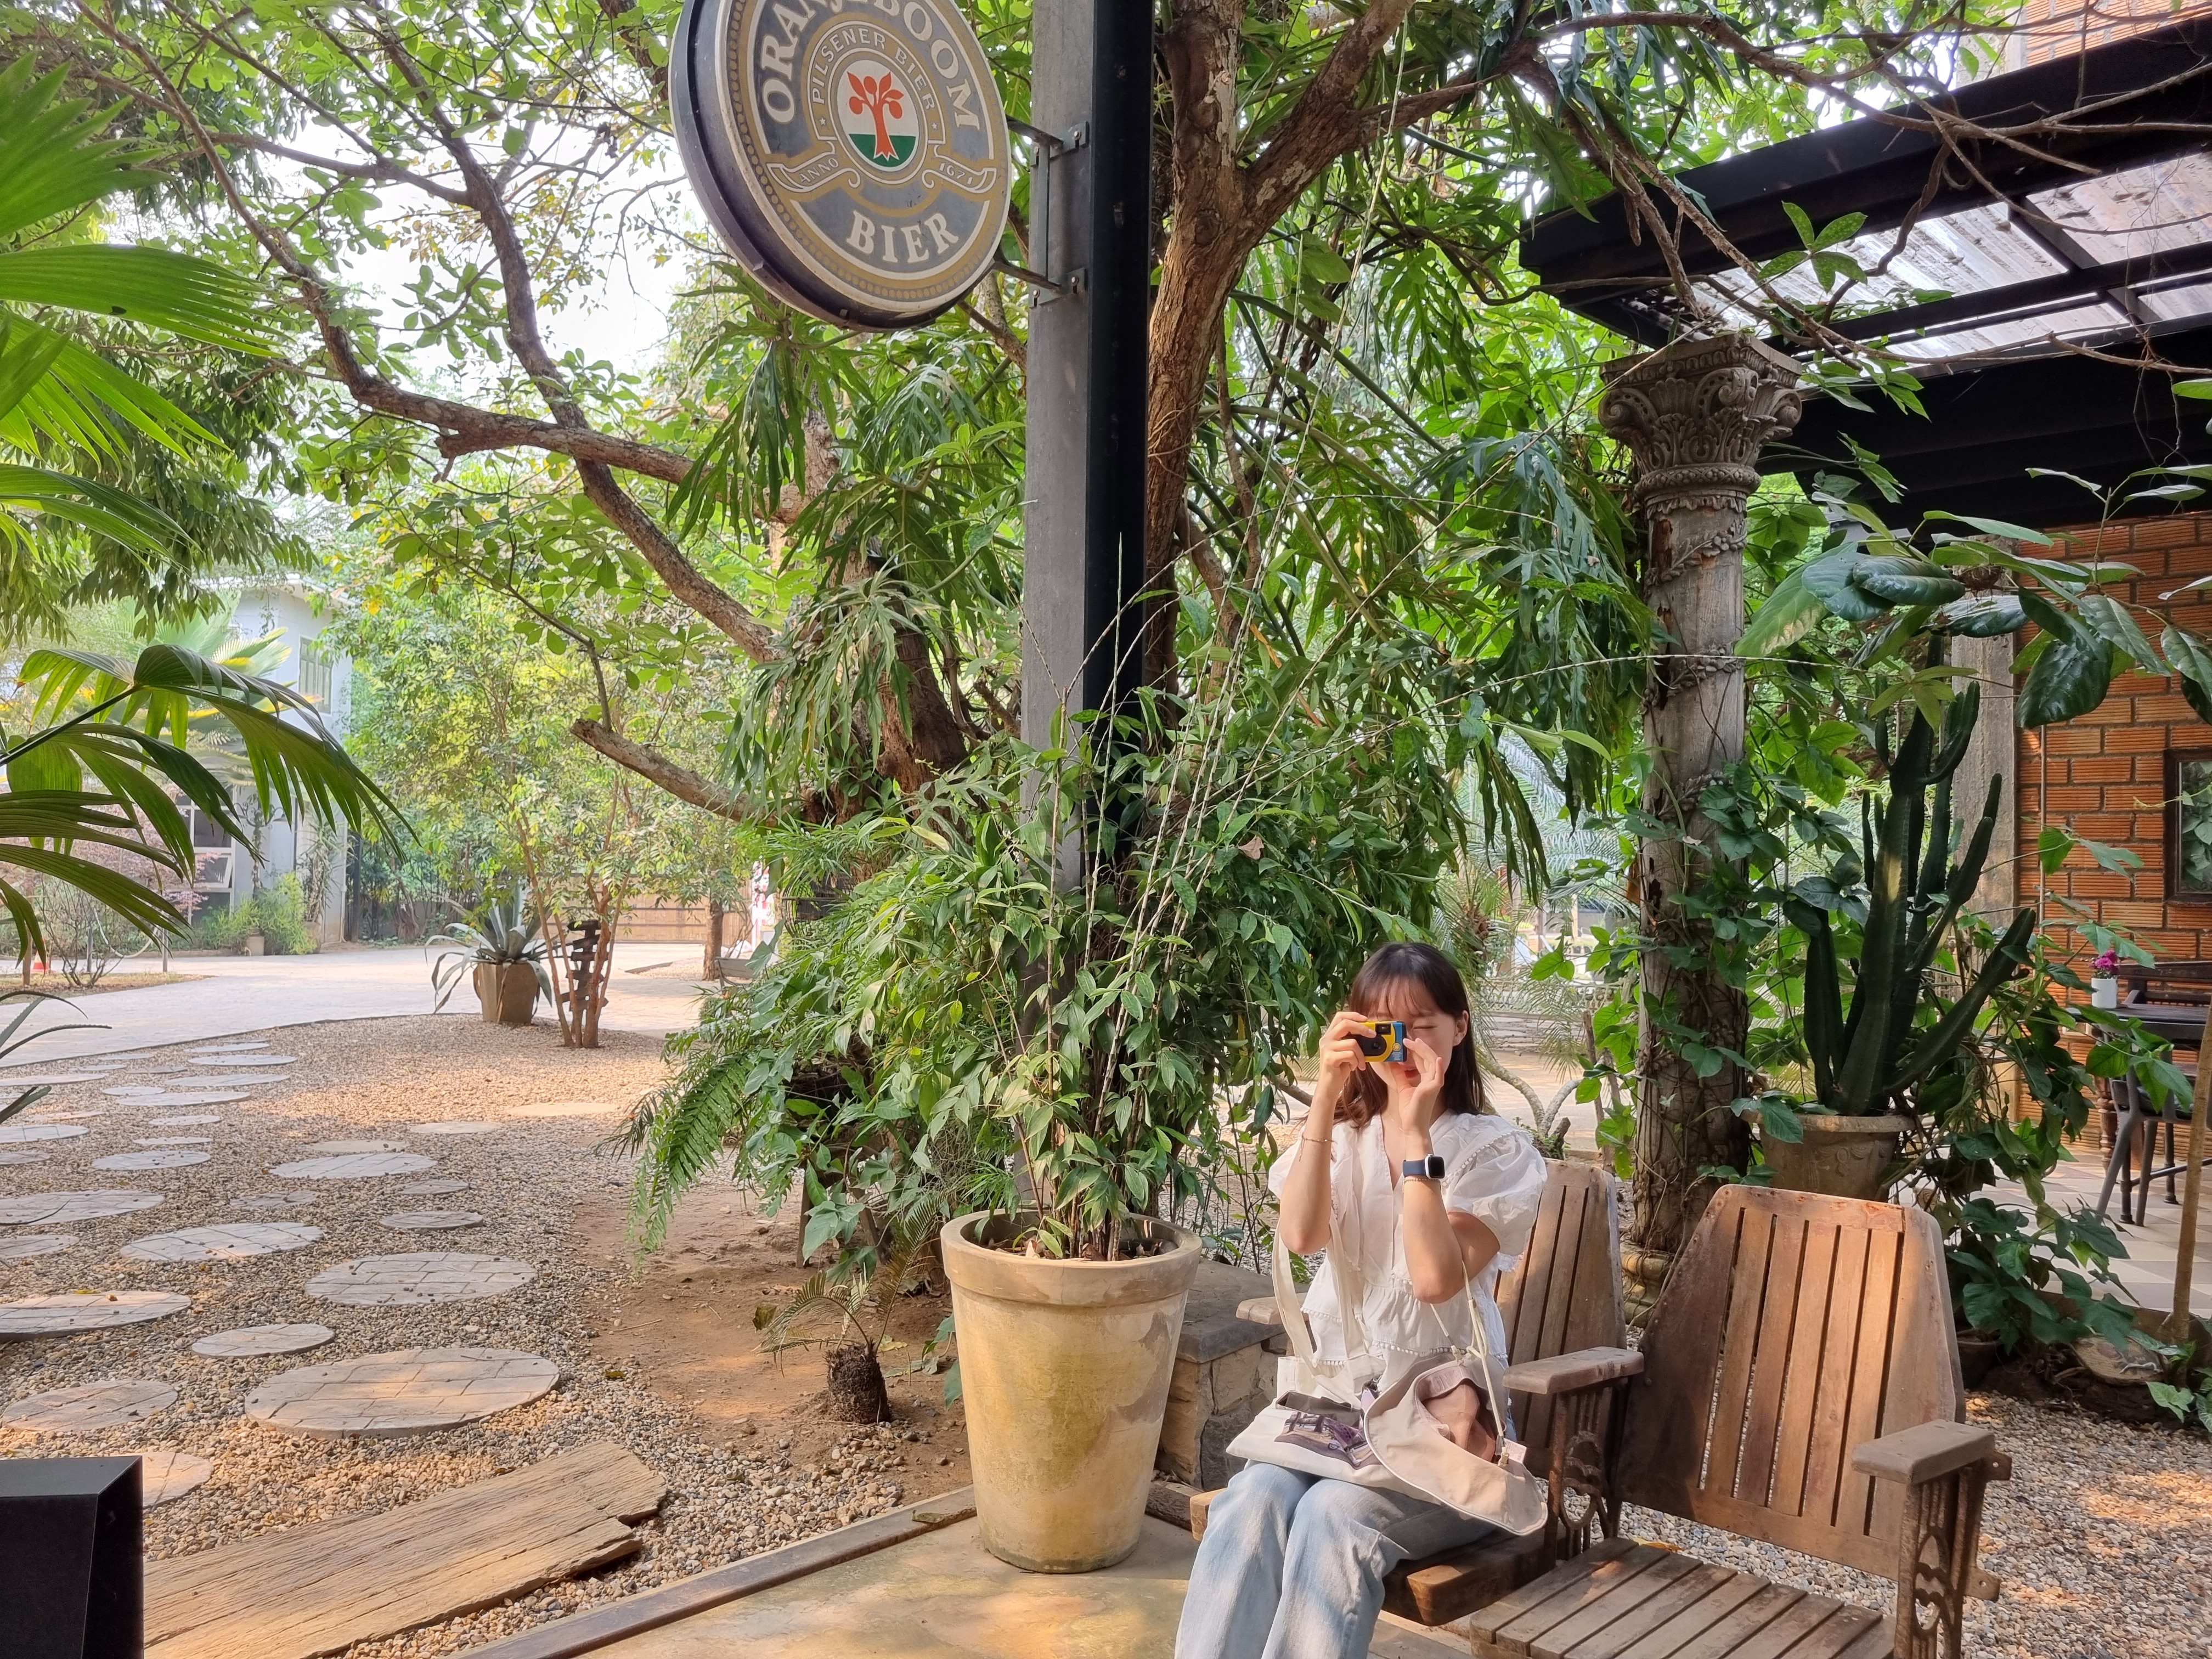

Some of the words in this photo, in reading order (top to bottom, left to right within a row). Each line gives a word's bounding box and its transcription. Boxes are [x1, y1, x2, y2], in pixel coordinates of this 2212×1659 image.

[760, 0, 980, 130] ORAOOM
[812, 27, 885, 105] PILSENER
[895, 47, 935, 110] BIER
[799, 157, 839, 183] ANNO
[939, 162, 974, 185] 1671
[846, 210, 960, 264] BIER
